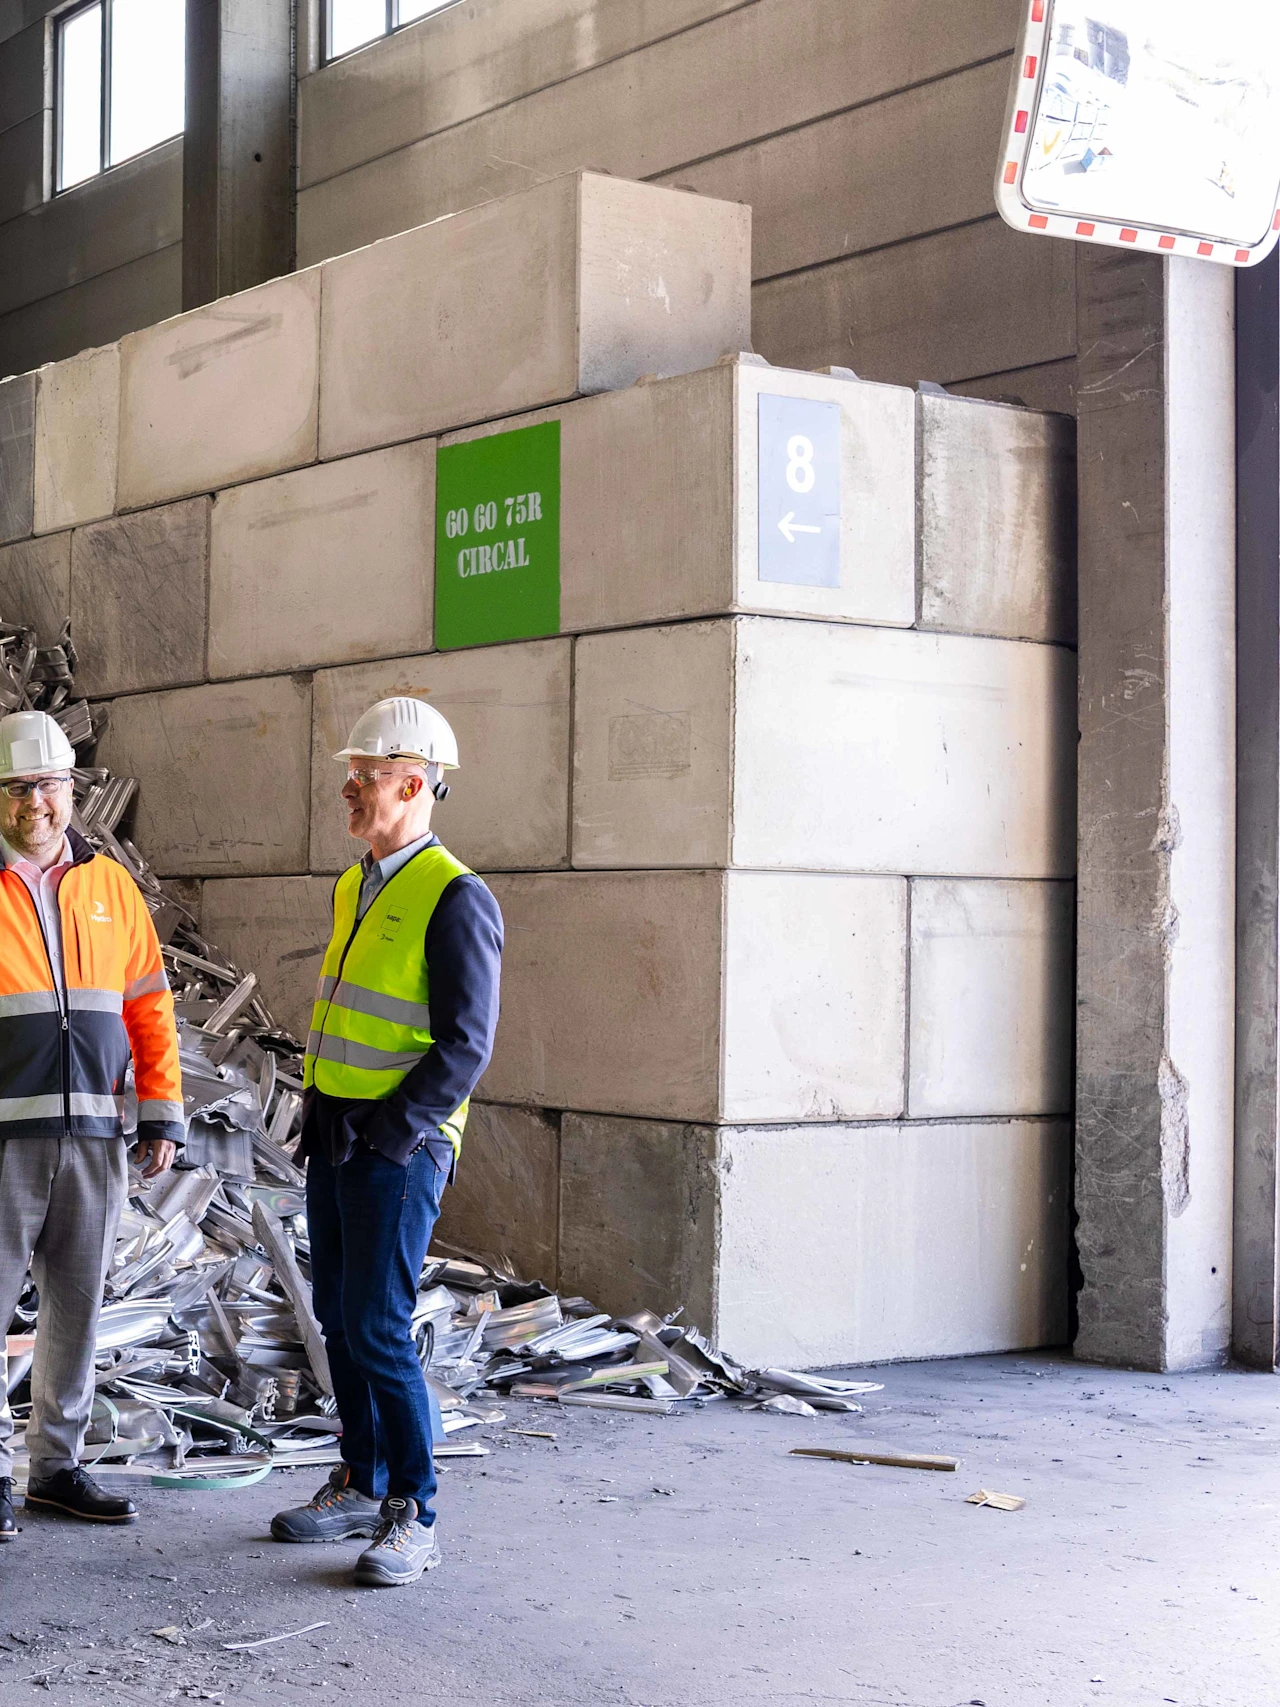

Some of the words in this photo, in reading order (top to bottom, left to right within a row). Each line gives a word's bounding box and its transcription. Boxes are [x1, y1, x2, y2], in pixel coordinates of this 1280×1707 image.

[785, 434, 815, 494] 8
[445, 508, 469, 539] 60
[473, 501, 497, 533] 60
[504, 491, 543, 528] 75R
[457, 537, 530, 578] CIRCAL
[90, 913, 113, 923] Hydro
